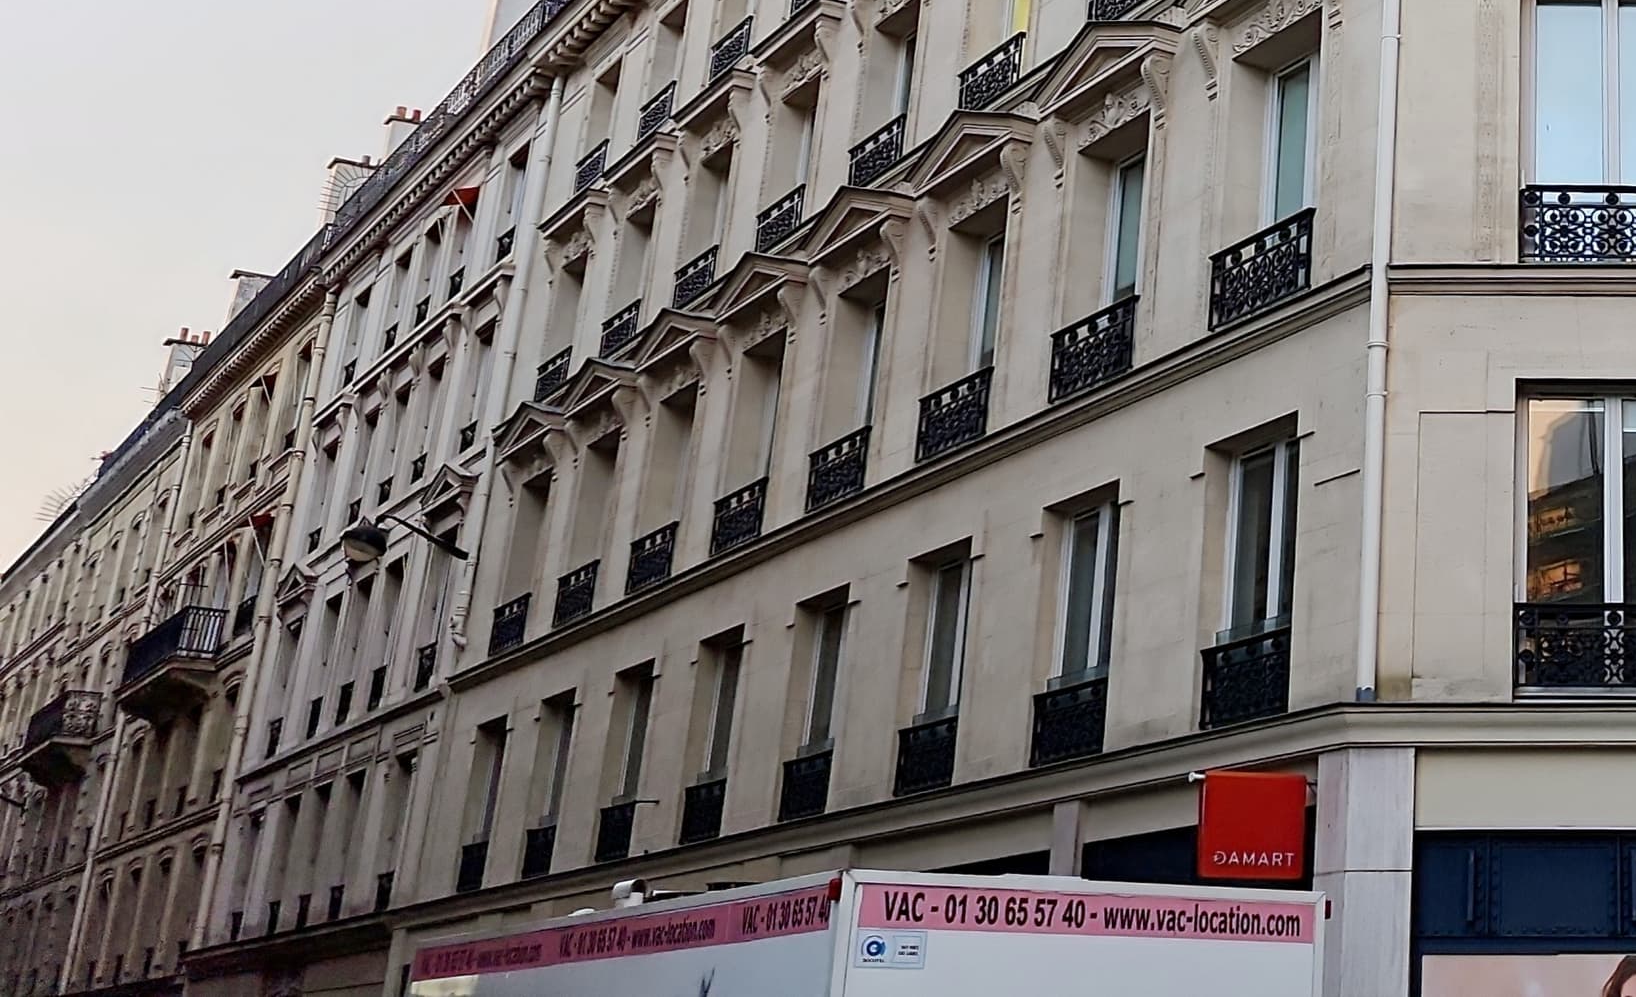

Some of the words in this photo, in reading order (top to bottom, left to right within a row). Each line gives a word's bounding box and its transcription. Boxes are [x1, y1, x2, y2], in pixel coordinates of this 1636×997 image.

[1212, 851, 1295, 867] DAMART
[742, 904, 760, 936] VAC
[766, 902, 778, 932] 01
[778, 900, 791, 931] 30
[791, 898, 805, 928] 65
[805, 896, 818, 926] 57
[884, 890, 926, 923] VAC
[944, 894, 968, 924] 01
[974, 895, 999, 926] 30
[1005, 897, 1029, 926] 65
[1034, 899, 1058, 927] 57
[1062, 899, 1087, 929] 40
[1103, 903, 1301, 937] www.vac-location.com
